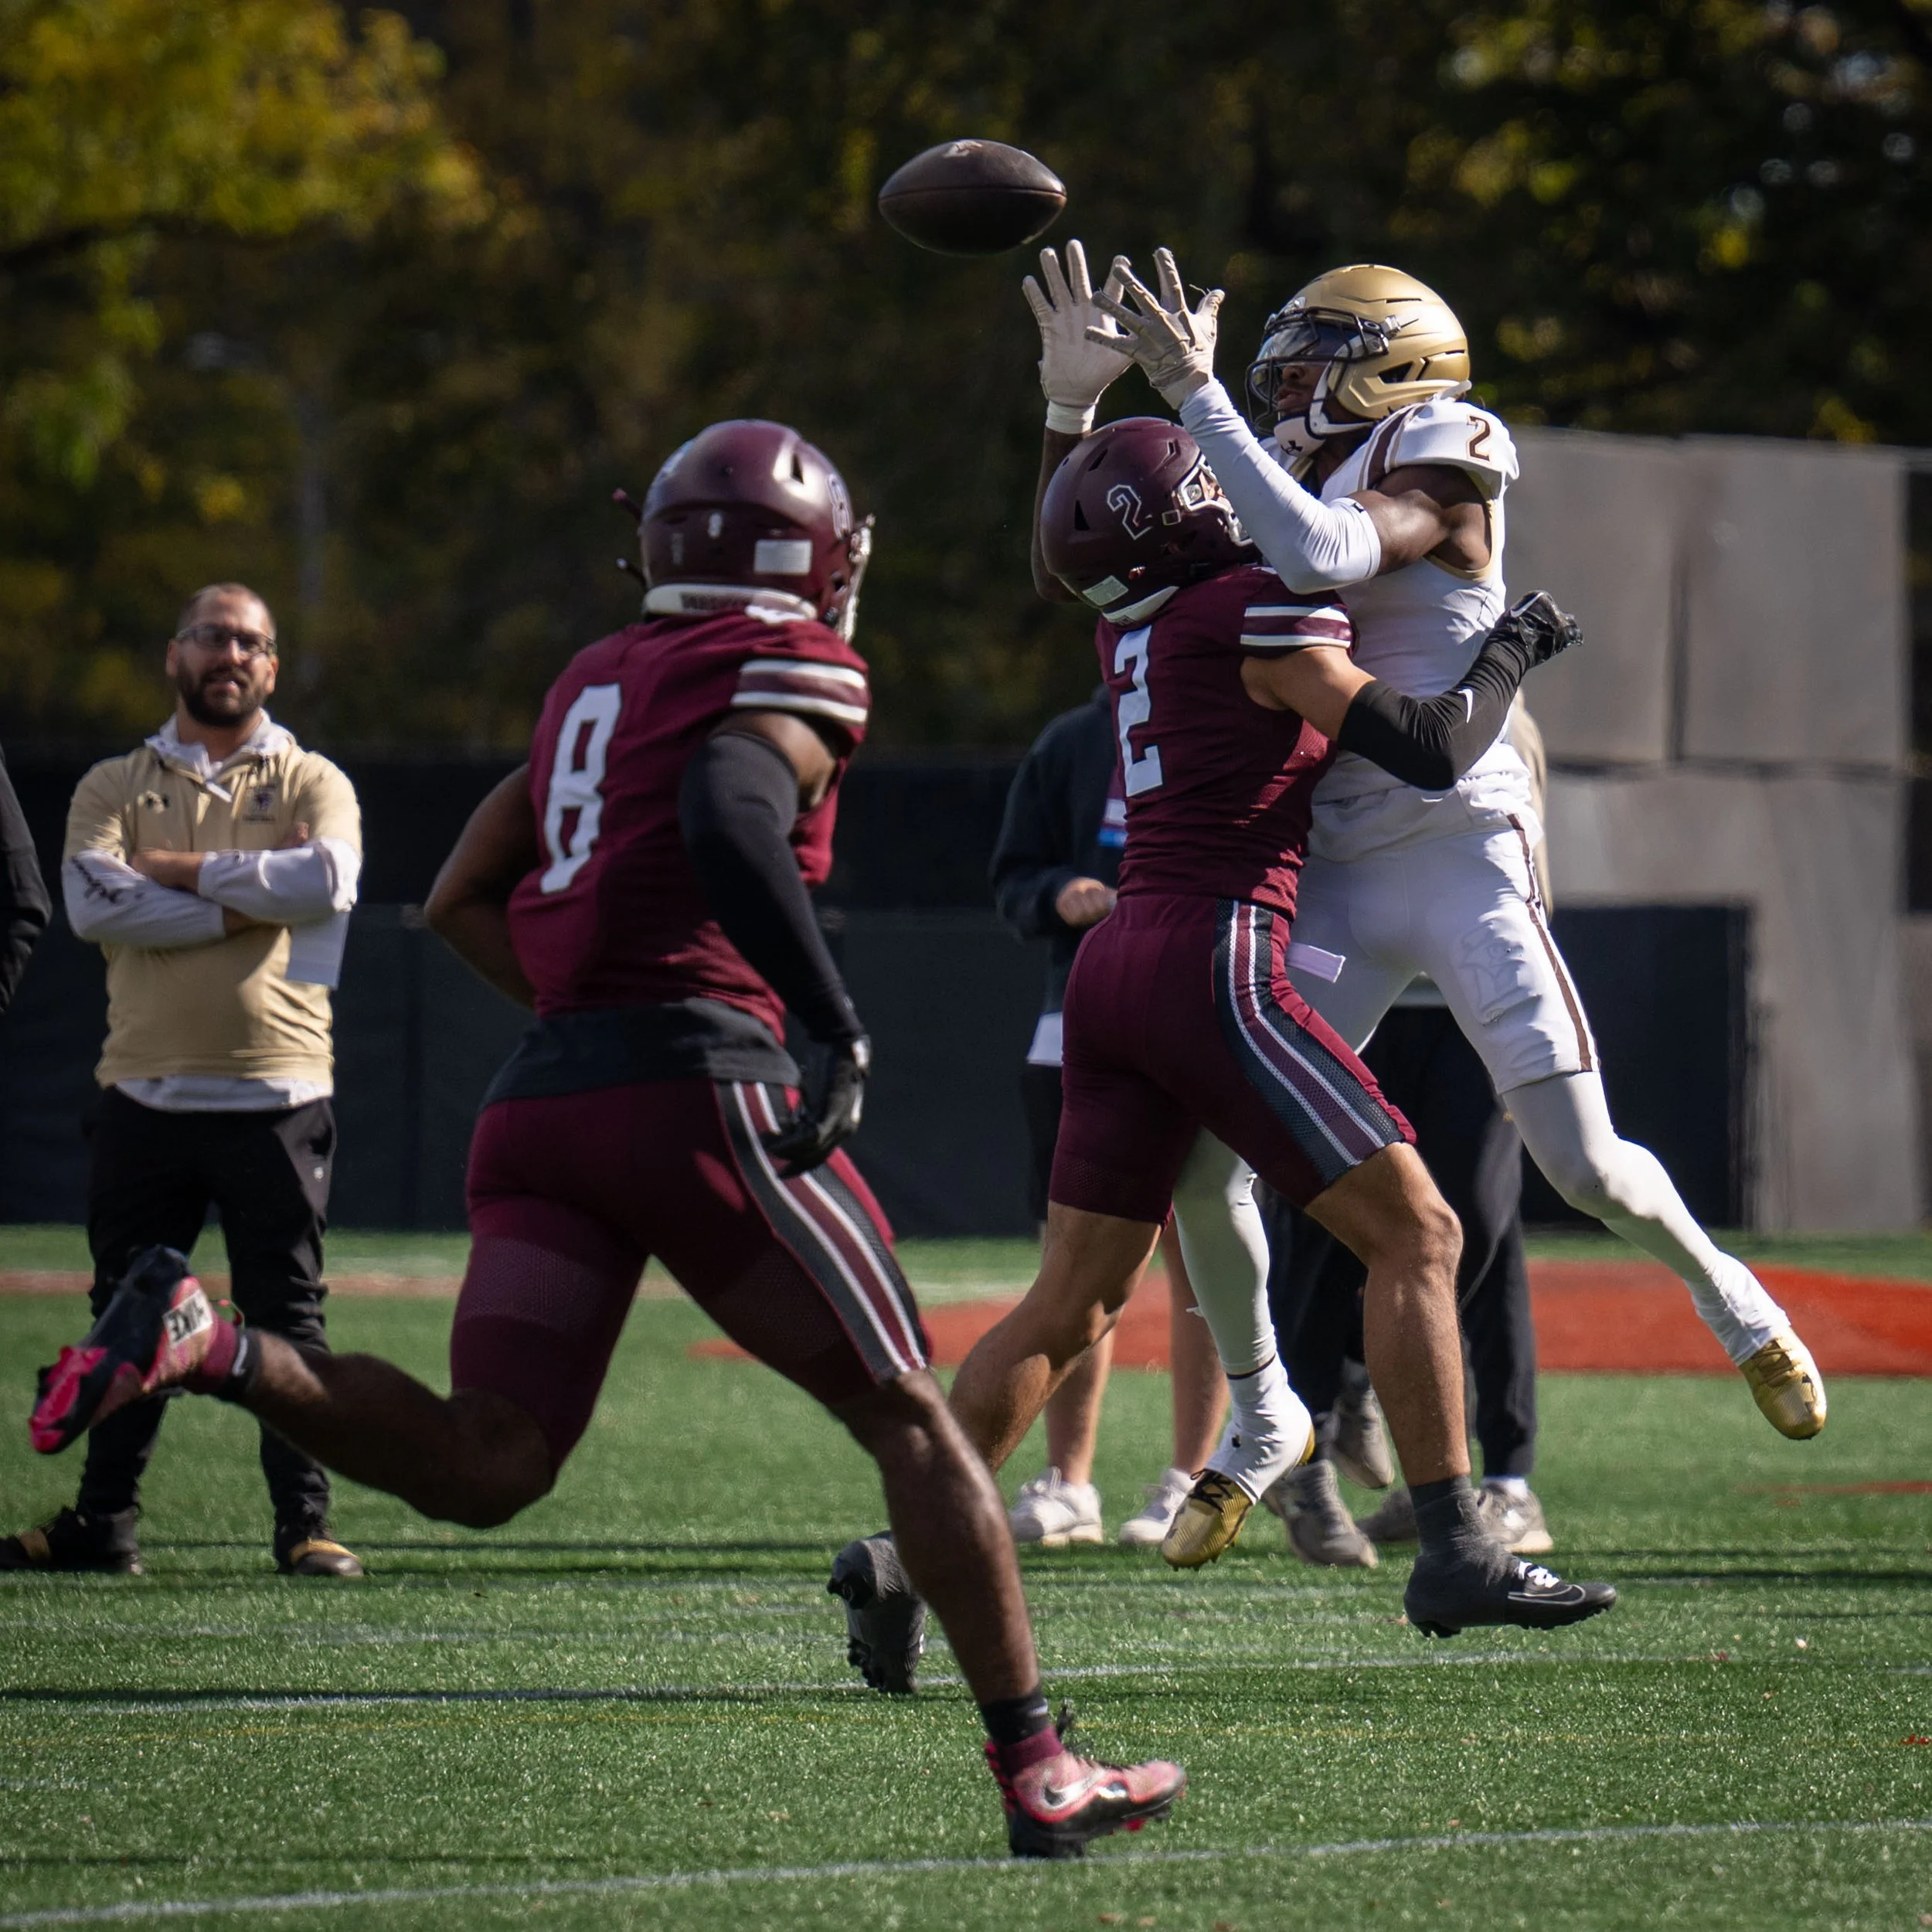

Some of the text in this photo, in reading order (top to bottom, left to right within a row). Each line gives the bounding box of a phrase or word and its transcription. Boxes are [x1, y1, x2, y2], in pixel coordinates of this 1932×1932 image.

[1465, 414, 1492, 463] 2
[1107, 484, 1154, 539] 2
[1114, 624, 1163, 798] 2
[539, 682, 622, 895] 8
